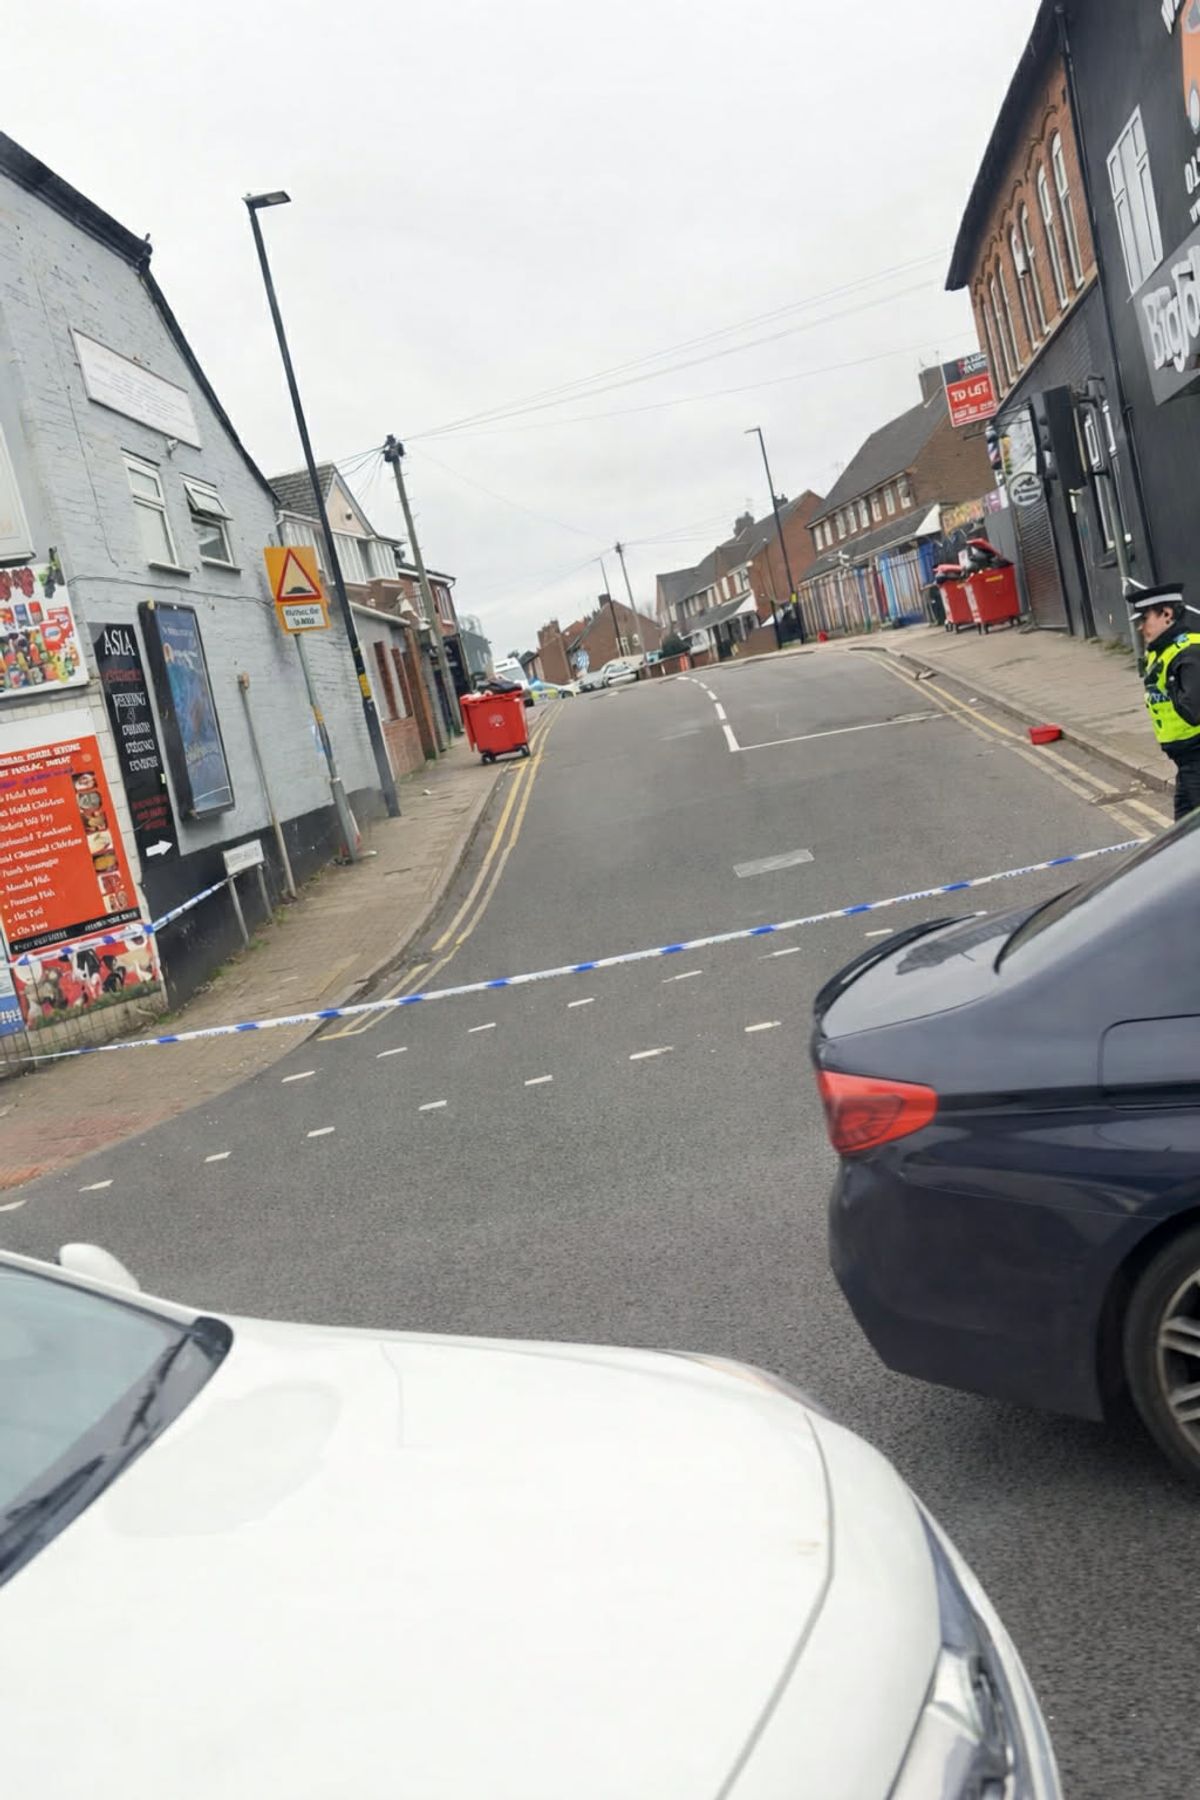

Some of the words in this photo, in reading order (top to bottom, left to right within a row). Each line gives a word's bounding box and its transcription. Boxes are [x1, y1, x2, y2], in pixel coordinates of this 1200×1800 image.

[951, 389, 967, 402] TO
[968, 381, 989, 397] LET
[104, 628, 136, 656] ASIA
